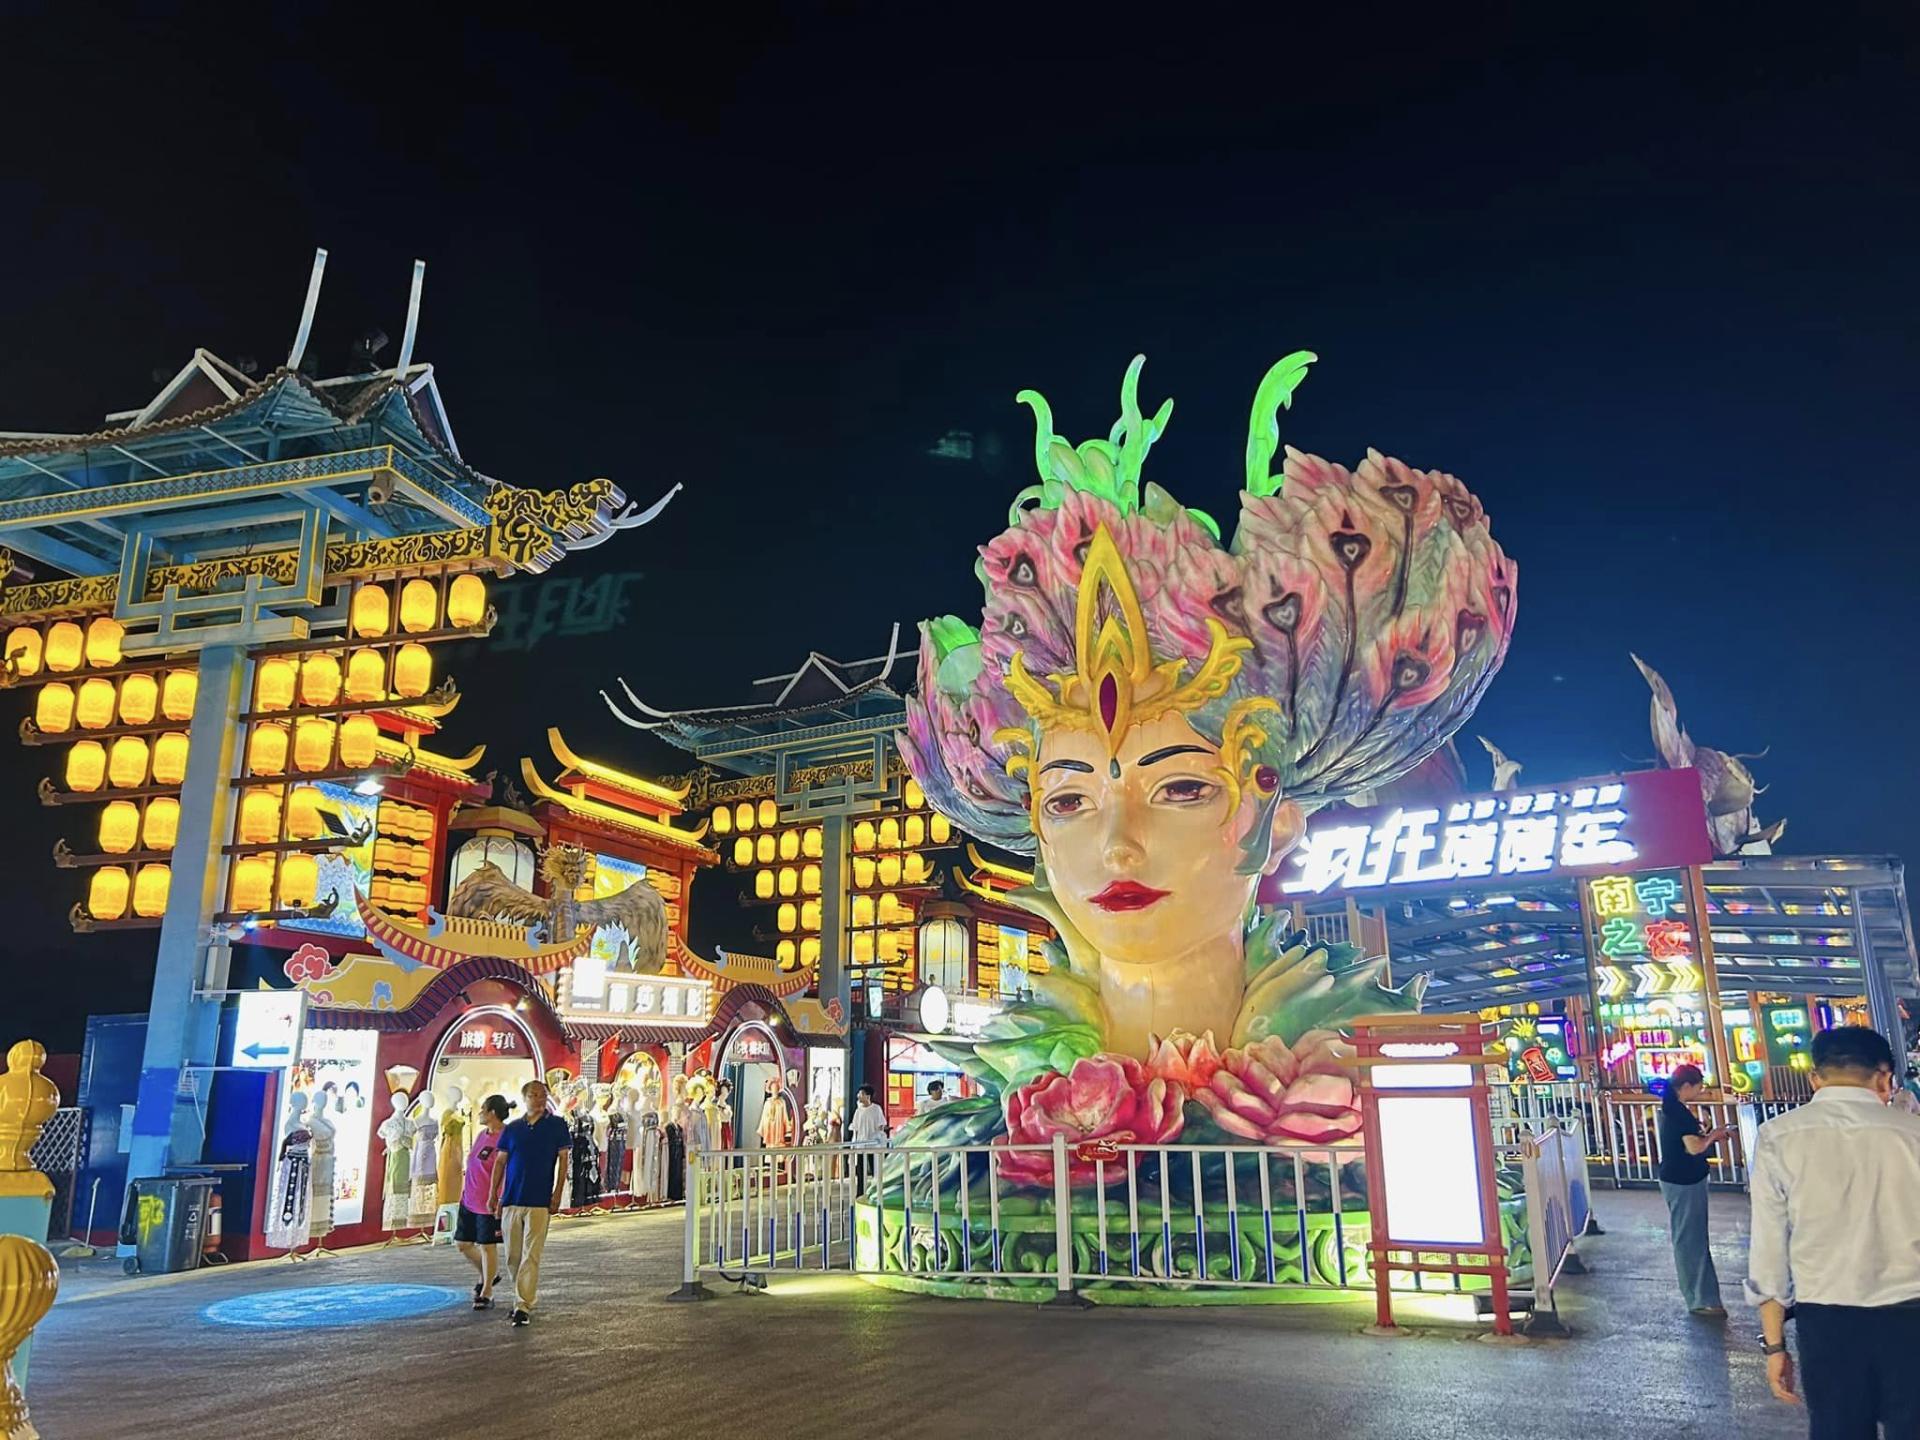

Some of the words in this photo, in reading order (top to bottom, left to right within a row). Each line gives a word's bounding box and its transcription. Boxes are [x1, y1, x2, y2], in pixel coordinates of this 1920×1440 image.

[1282, 808, 1639, 895] 疯狂碰碰车
[1590, 876, 1676, 916] 南宁
[1601, 919, 1692, 961] 之夜
[491, 1032, 516, 1050] 写真
